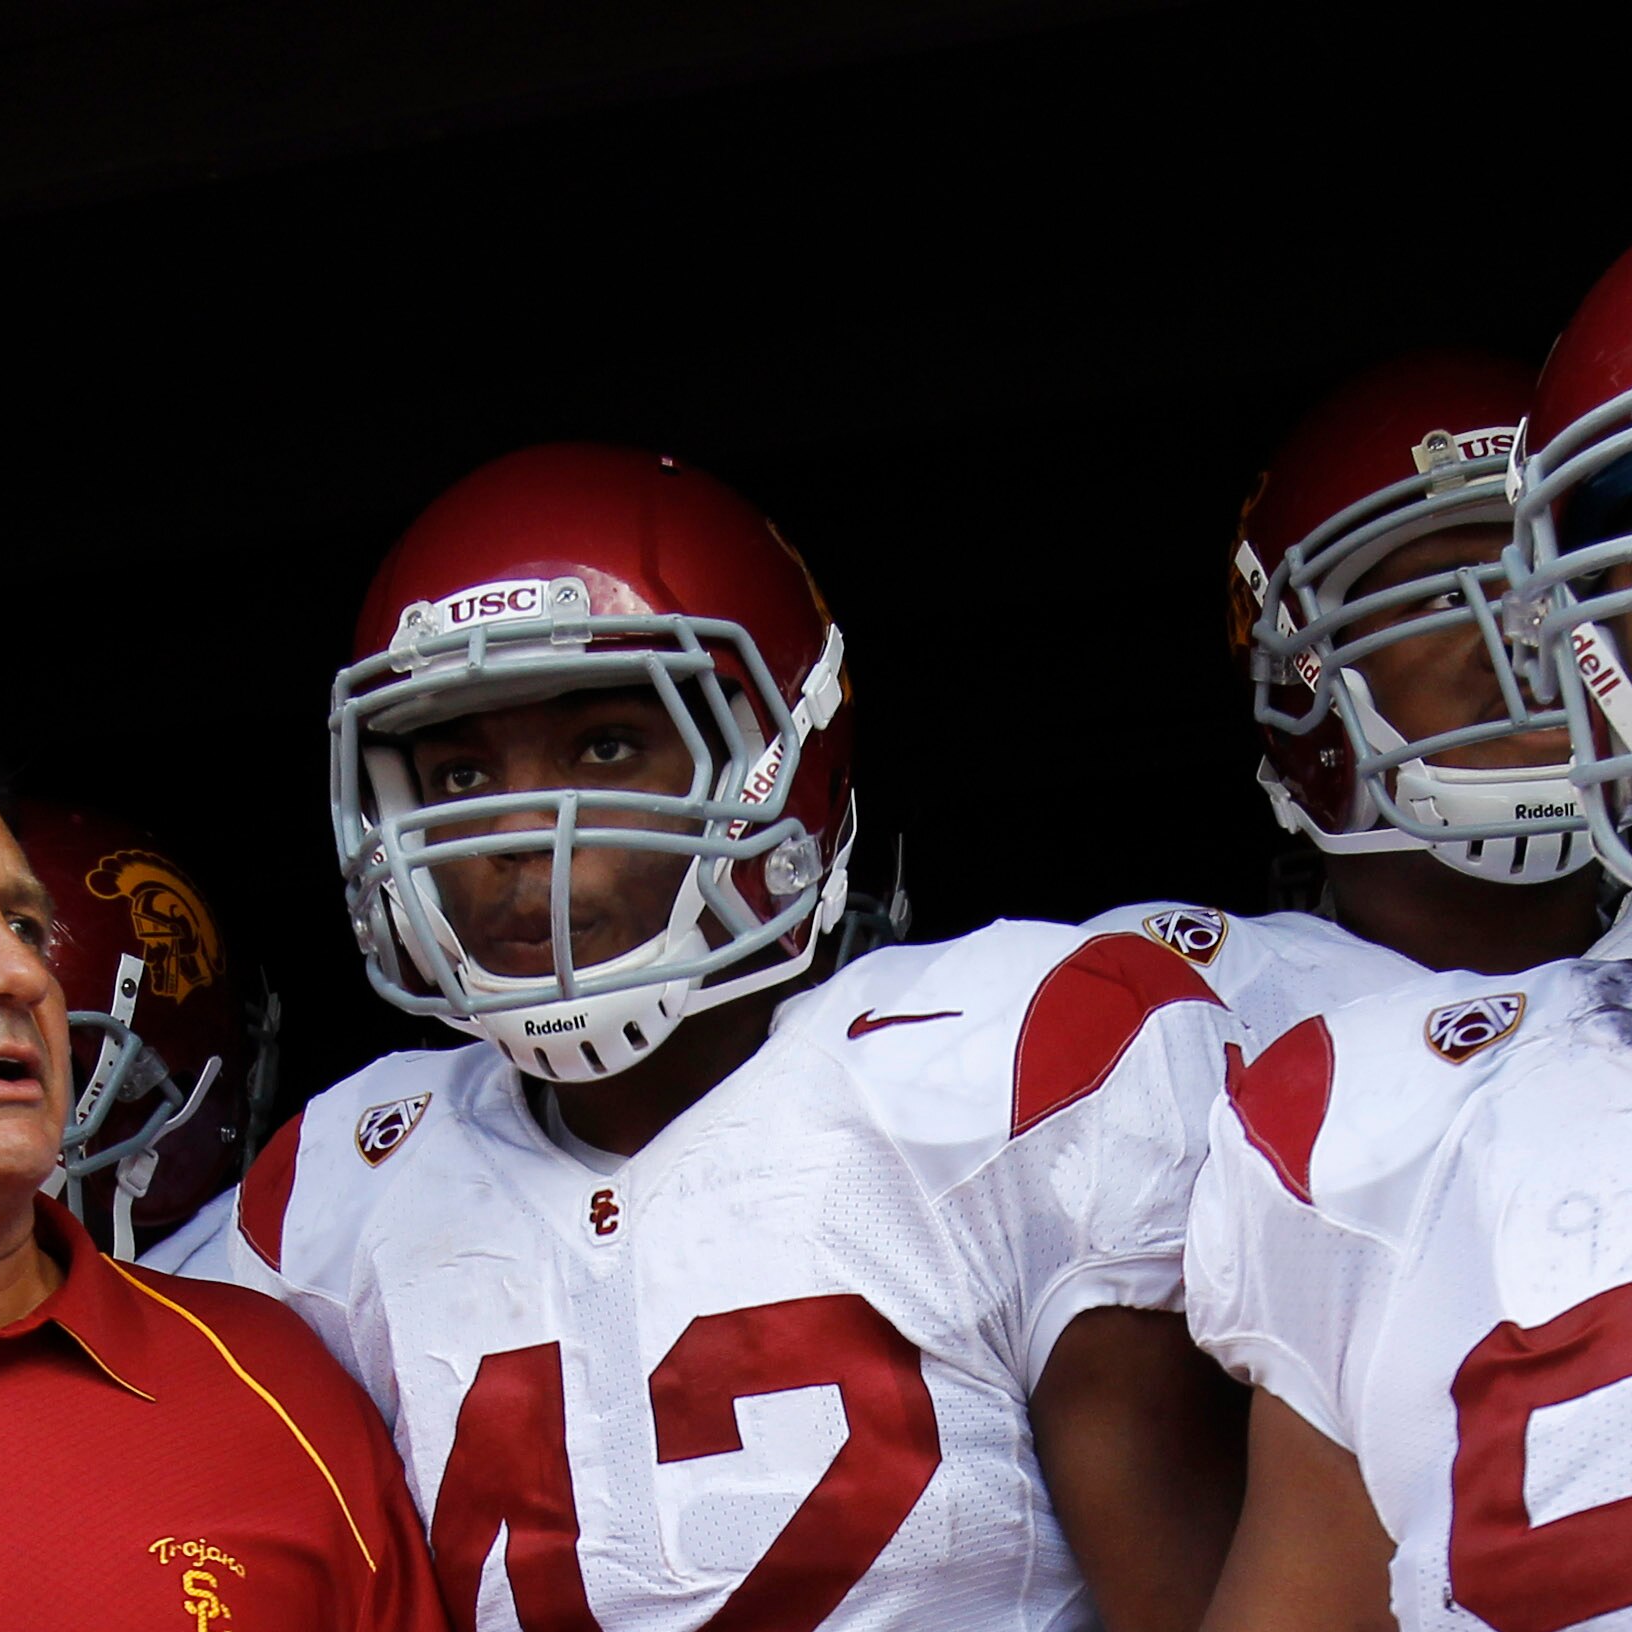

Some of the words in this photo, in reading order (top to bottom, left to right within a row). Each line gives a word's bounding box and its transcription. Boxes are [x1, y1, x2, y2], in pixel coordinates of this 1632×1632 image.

[1458, 434, 1515, 460] US
[449, 588, 537, 624] USC
[1515, 803, 1575, 819] Riddell
[524, 1014, 586, 1036] Riddell
[148, 1536, 246, 1578] Trojans
